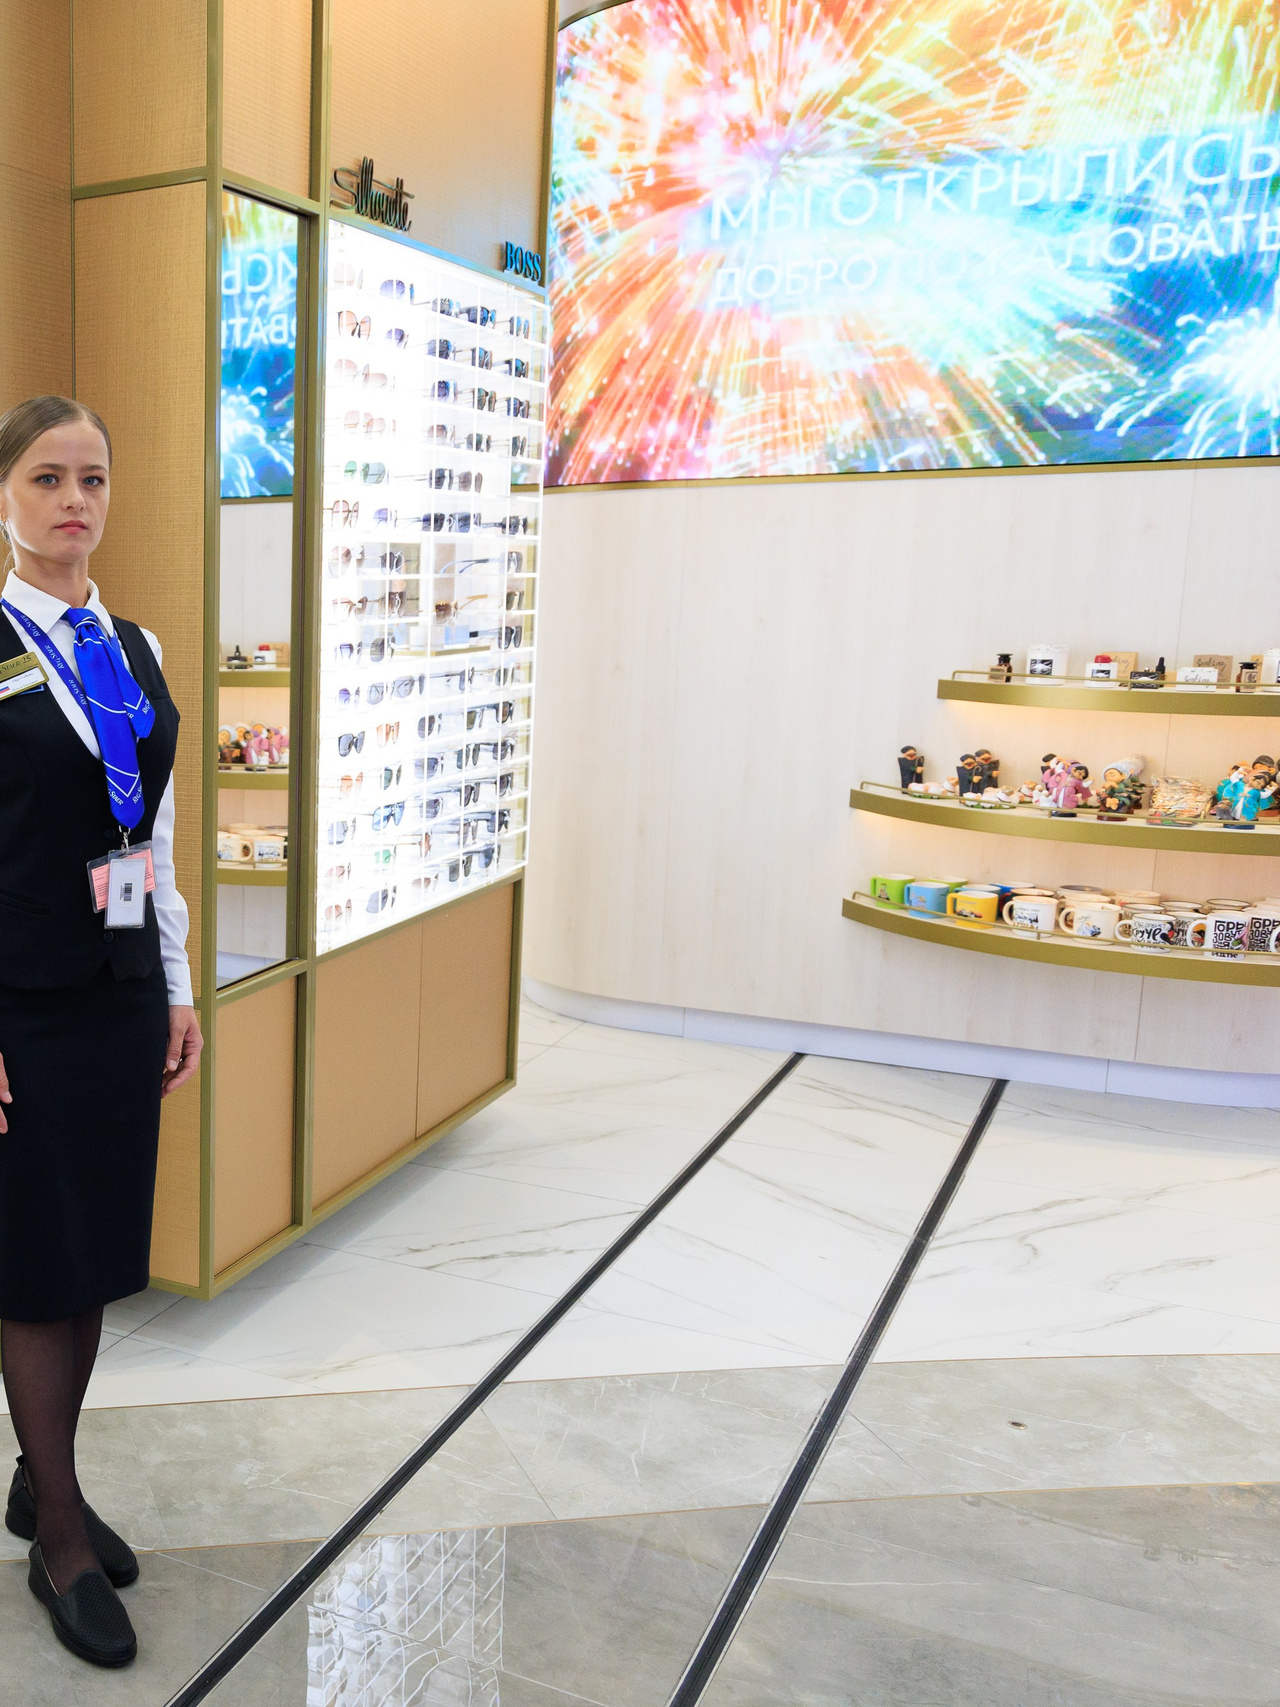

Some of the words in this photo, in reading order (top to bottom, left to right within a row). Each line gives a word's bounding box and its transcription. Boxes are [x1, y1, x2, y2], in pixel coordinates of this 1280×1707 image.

[709, 185, 812, 240] МЫ
[831, 128, 1280, 227] ОТКРЫЛИСЬ
[504, 241, 542, 282] BOSS
[712, 252, 878, 304] ДОБРО
